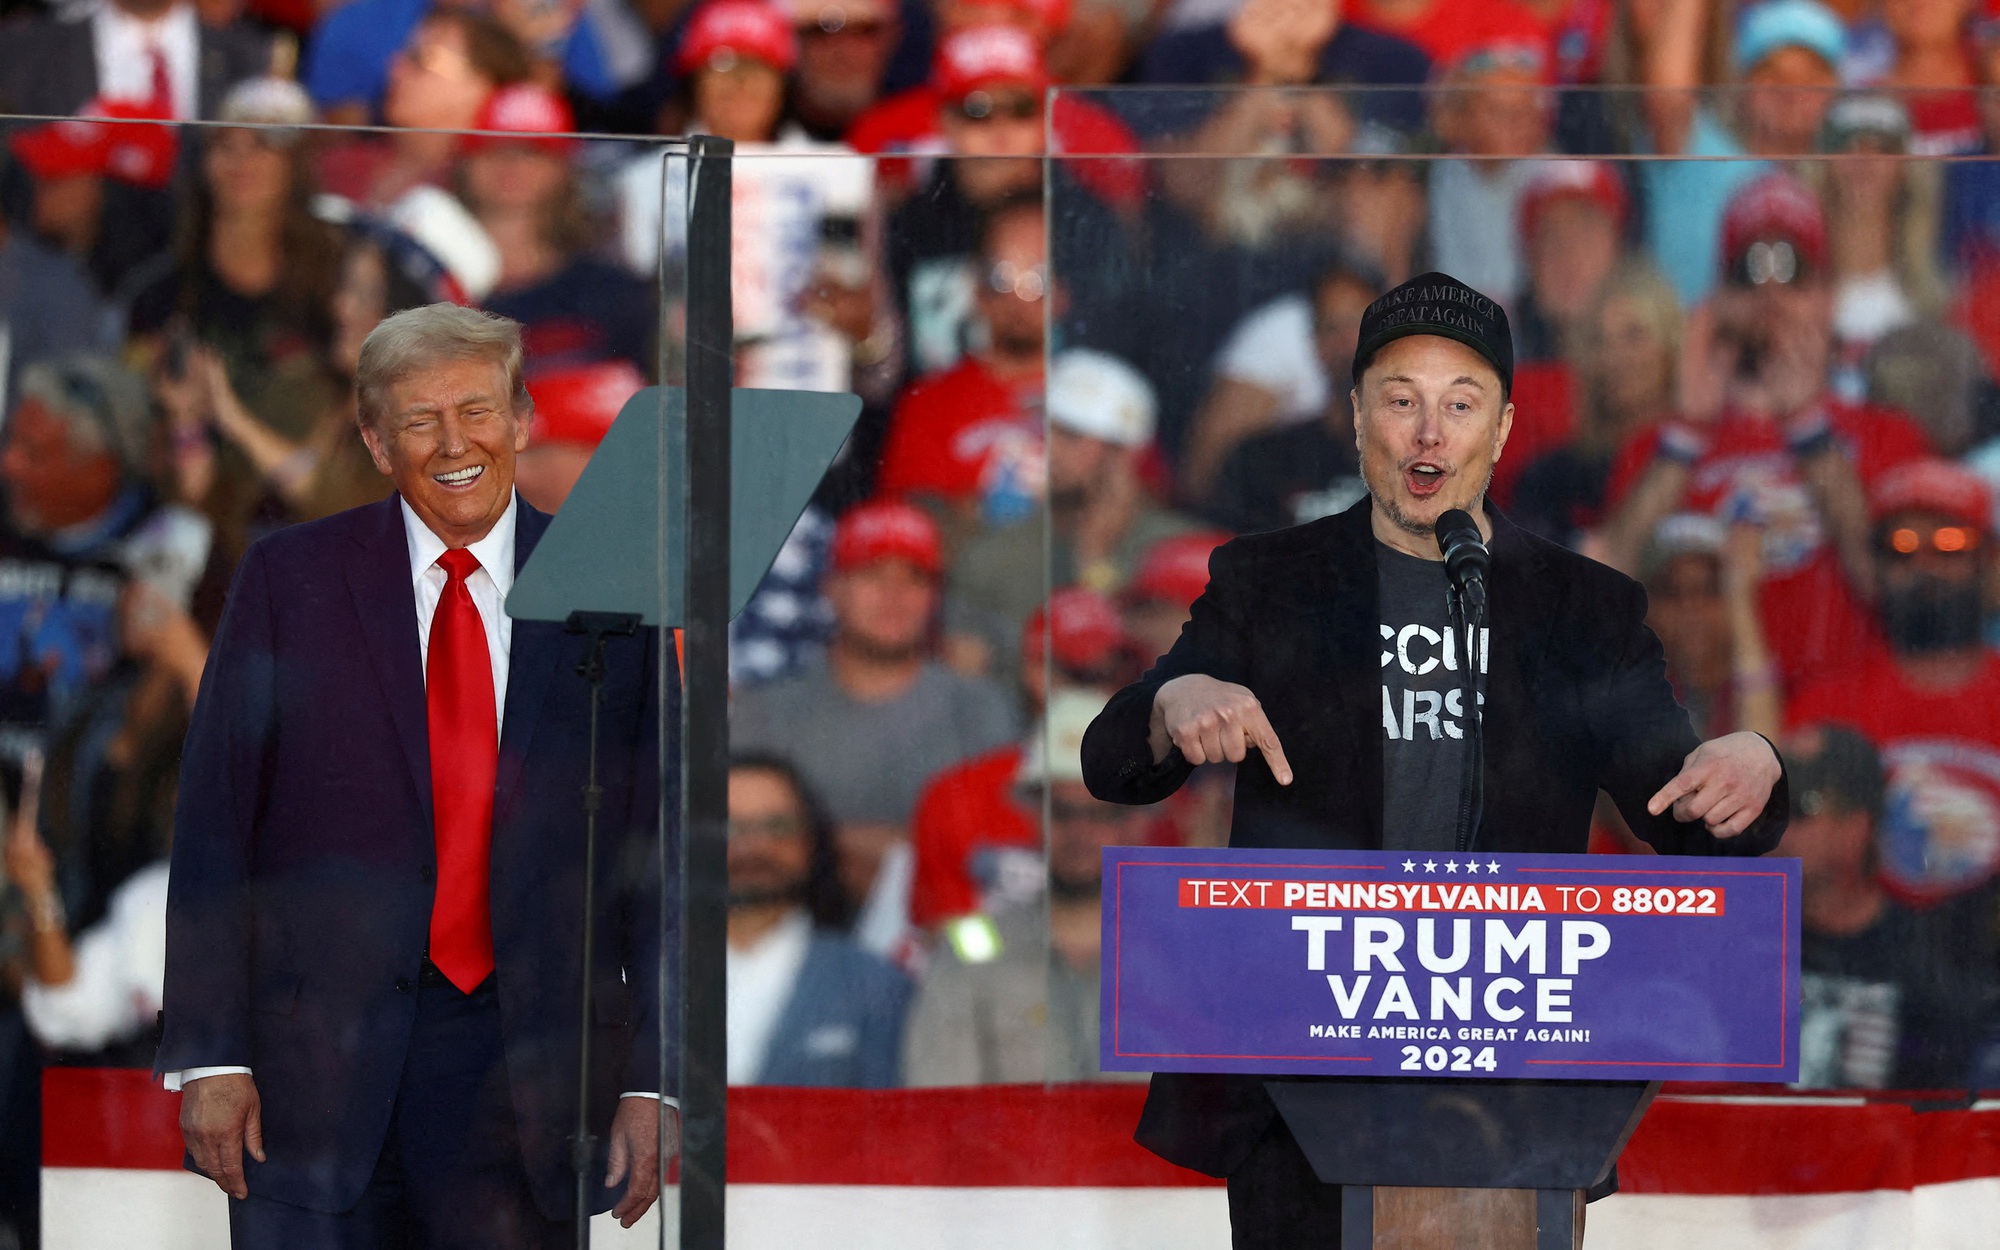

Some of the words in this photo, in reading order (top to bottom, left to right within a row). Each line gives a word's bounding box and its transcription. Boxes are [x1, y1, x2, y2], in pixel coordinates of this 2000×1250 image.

[1368, 287, 1415, 318] MAKE
[1418, 285, 1496, 322] AMERICA
[1379, 306, 1429, 331] GREAT
[1430, 306, 1485, 336] AGAIN
[1187, 880, 1273, 907] TEXT
[1284, 882, 1546, 911] PENNSYLVANIA
[1555, 886, 1601, 912] TO
[1612, 887, 1717, 914] 88022
[1291, 915, 1611, 975] TRUMP
[1326, 974, 1573, 1023] VANCE
[1309, 1024, 1362, 1039] MAKE
[1367, 1025, 1452, 1040] AMERICA
[1457, 1027, 1519, 1042] GREAT
[1524, 1028, 1590, 1043] AGAIN!
[1400, 1045, 1498, 1072] 2024
